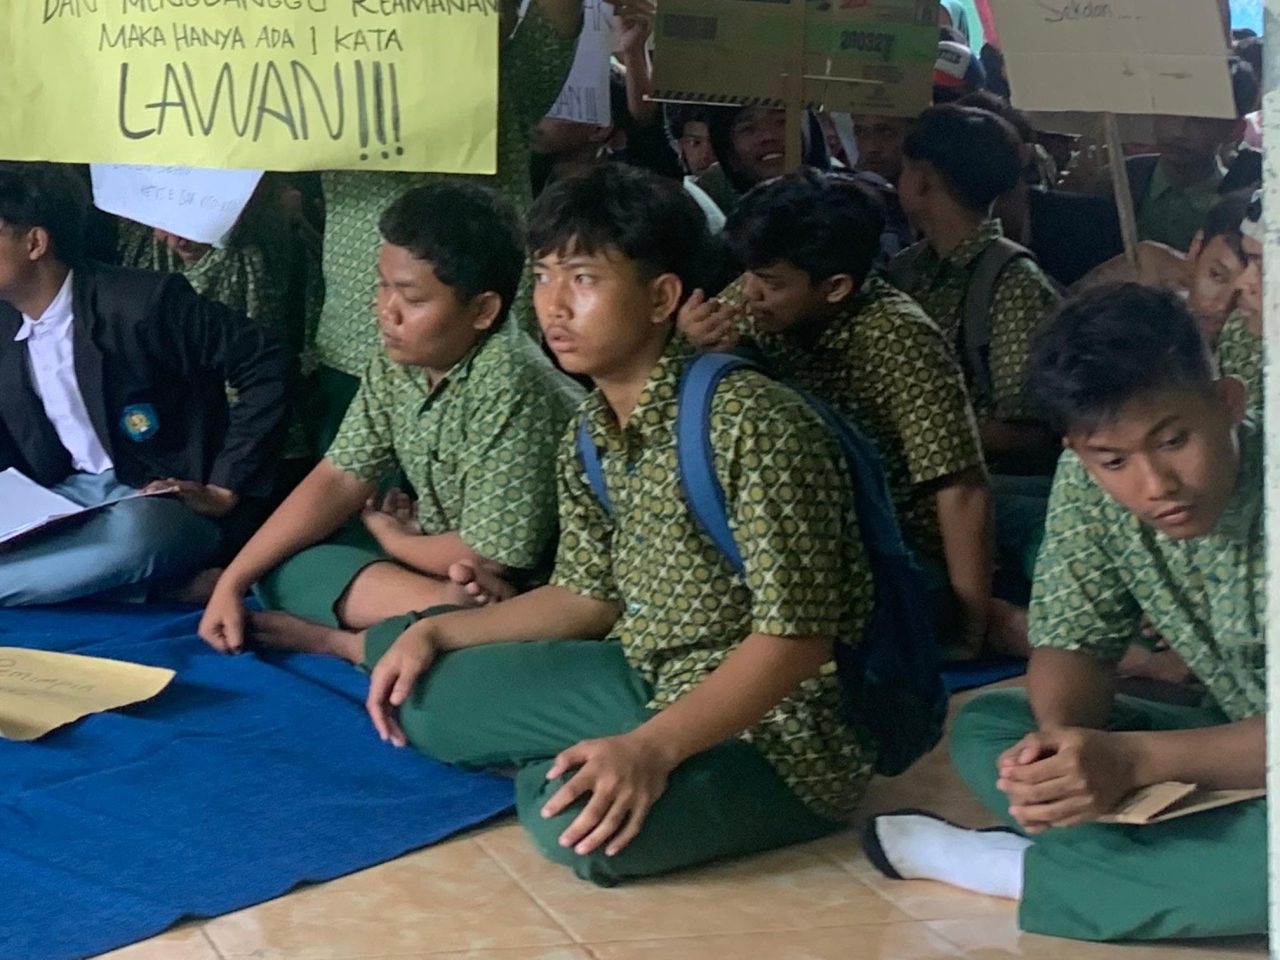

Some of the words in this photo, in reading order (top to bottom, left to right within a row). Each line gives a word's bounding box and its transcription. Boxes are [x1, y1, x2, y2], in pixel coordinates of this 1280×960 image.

[99, 23, 167, 51] MAKA
[173, 22, 246, 52] HANYA
[255, 25, 295, 49] ADA
[335, 25, 404, 53] KATA
[118, 59, 404, 161] LAWAN!!!
